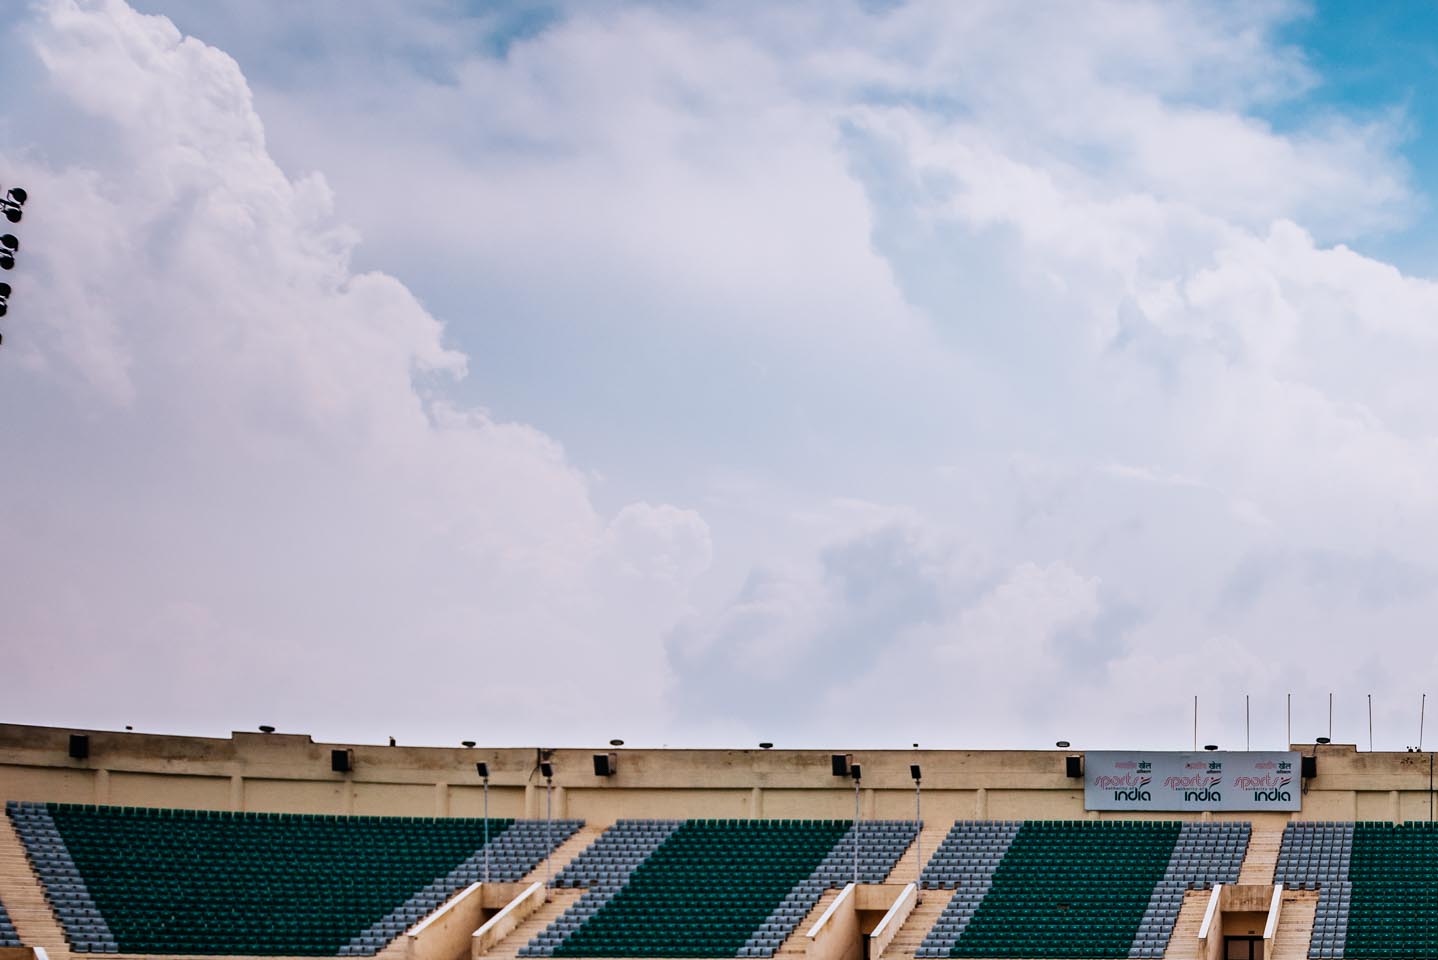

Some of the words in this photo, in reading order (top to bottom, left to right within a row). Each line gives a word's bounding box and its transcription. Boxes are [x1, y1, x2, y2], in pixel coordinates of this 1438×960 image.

[1095, 773, 1139, 790] sports
[1165, 774, 1210, 791] sports
[1235, 774, 1279, 791] sports
[1114, 788, 1151, 801] india
[1184, 789, 1221, 801] india
[1254, 789, 1291, 801] india
